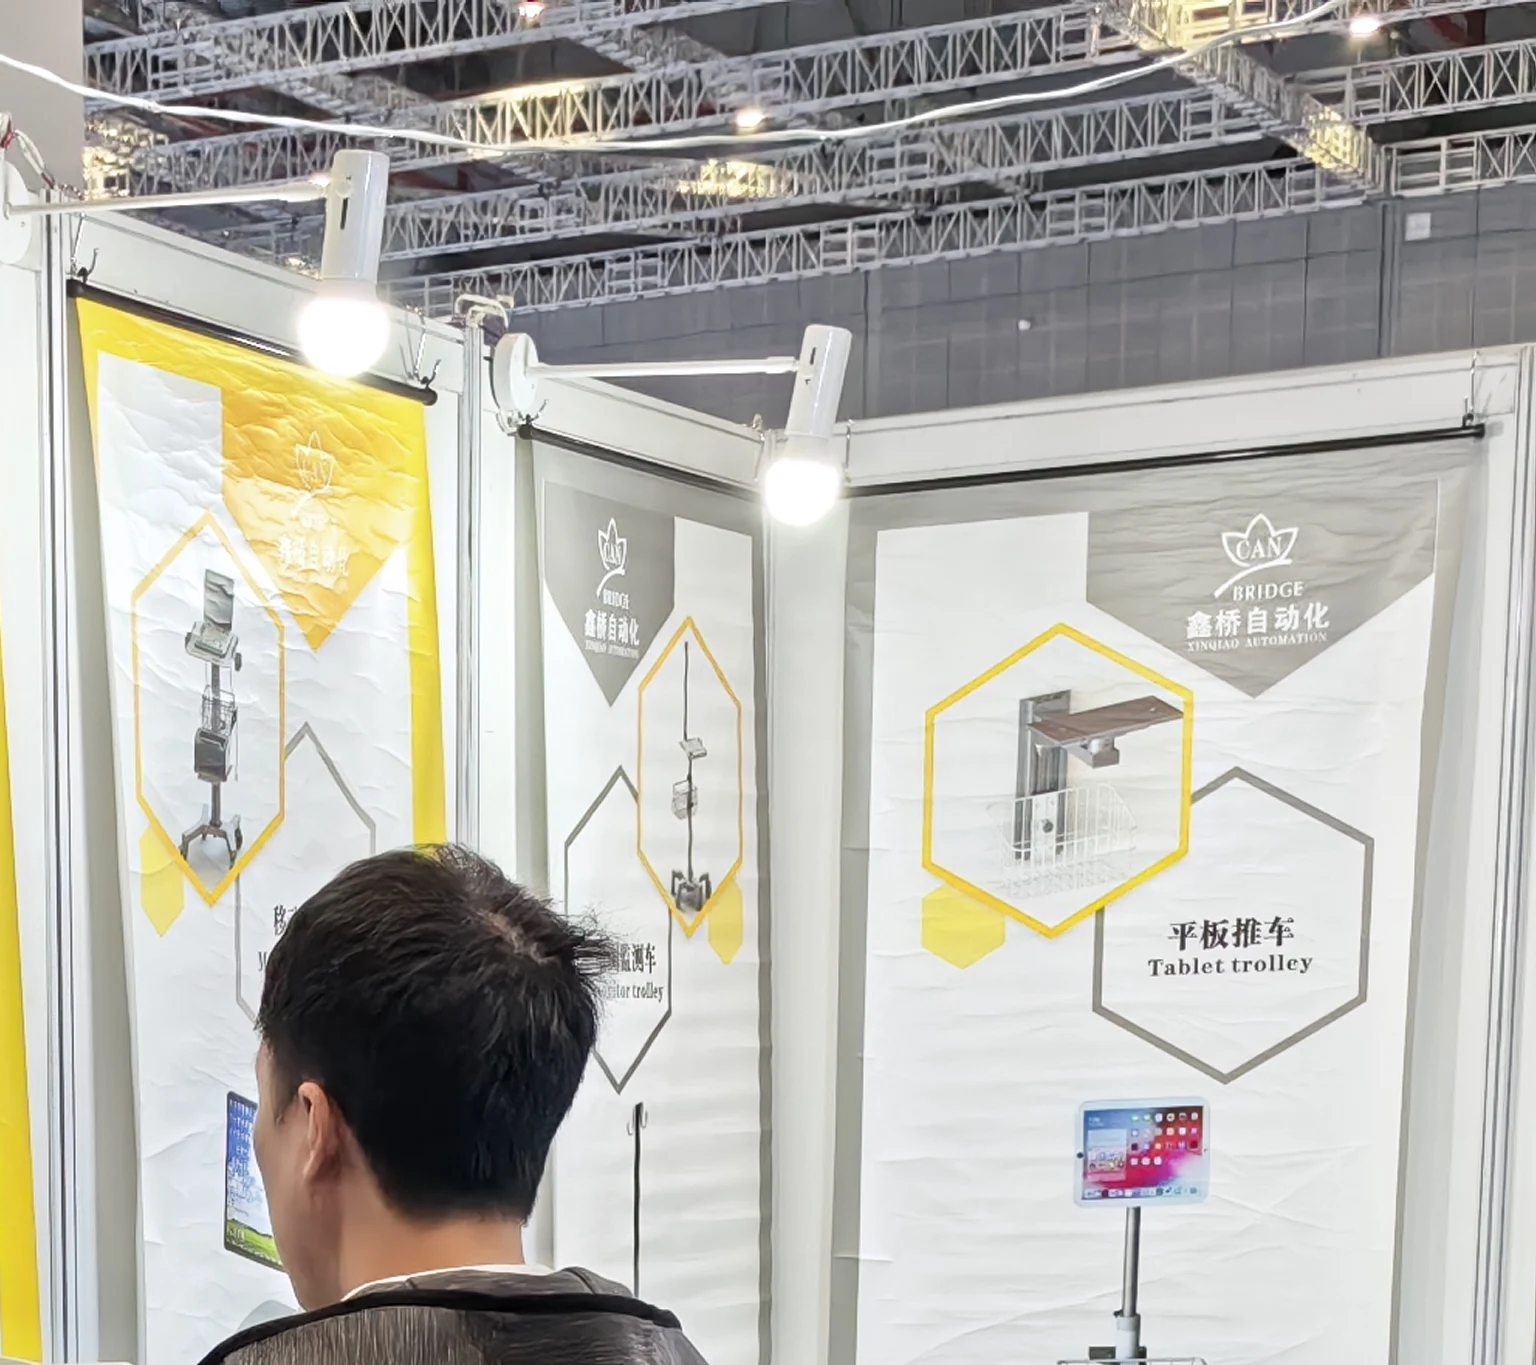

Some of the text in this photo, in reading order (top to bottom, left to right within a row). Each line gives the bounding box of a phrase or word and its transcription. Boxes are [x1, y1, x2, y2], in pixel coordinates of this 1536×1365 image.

[1236, 536, 1282, 560] CAN
[1233, 581, 1304, 601] BRIDGE
[1186, 601, 1330, 639] 鑫桥自动化
[1187, 631, 1327, 652] XINQIAO AUTOMATION
[273, 904, 298, 937] 移
[1167, 916, 1295, 951] 平板推车
[615, 943, 656, 974] 监测车
[1148, 954, 1313, 977] Tablet trolley
[632, 982, 664, 1003] trolley
